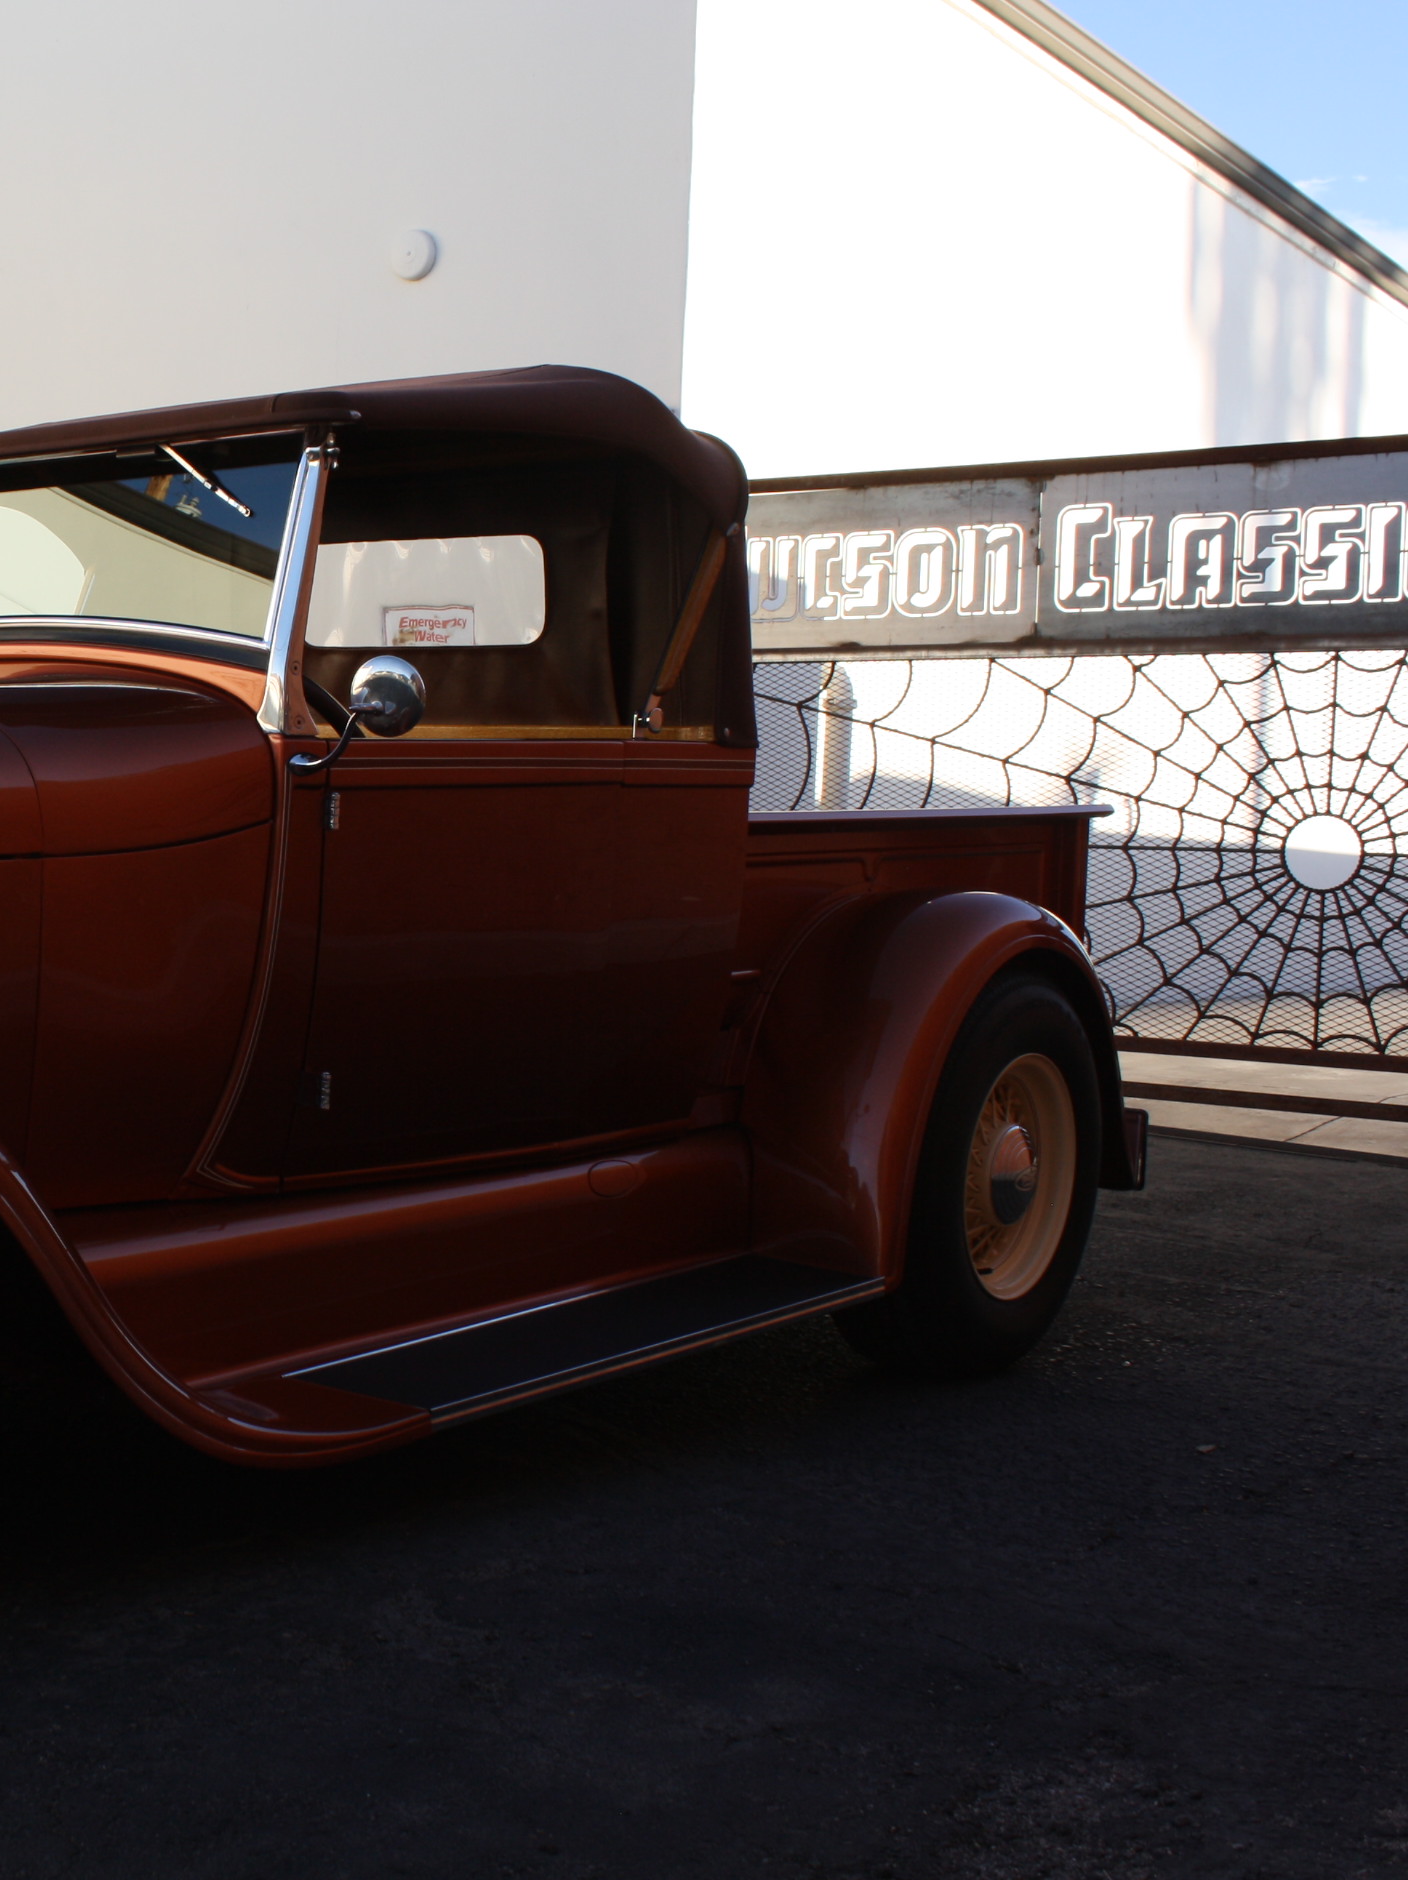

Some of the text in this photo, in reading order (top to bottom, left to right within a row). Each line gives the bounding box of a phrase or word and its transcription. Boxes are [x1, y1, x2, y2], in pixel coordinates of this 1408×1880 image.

[745, 501, 1408, 624] UCSON CLASSI
[414, 630, 450, 644] Water
